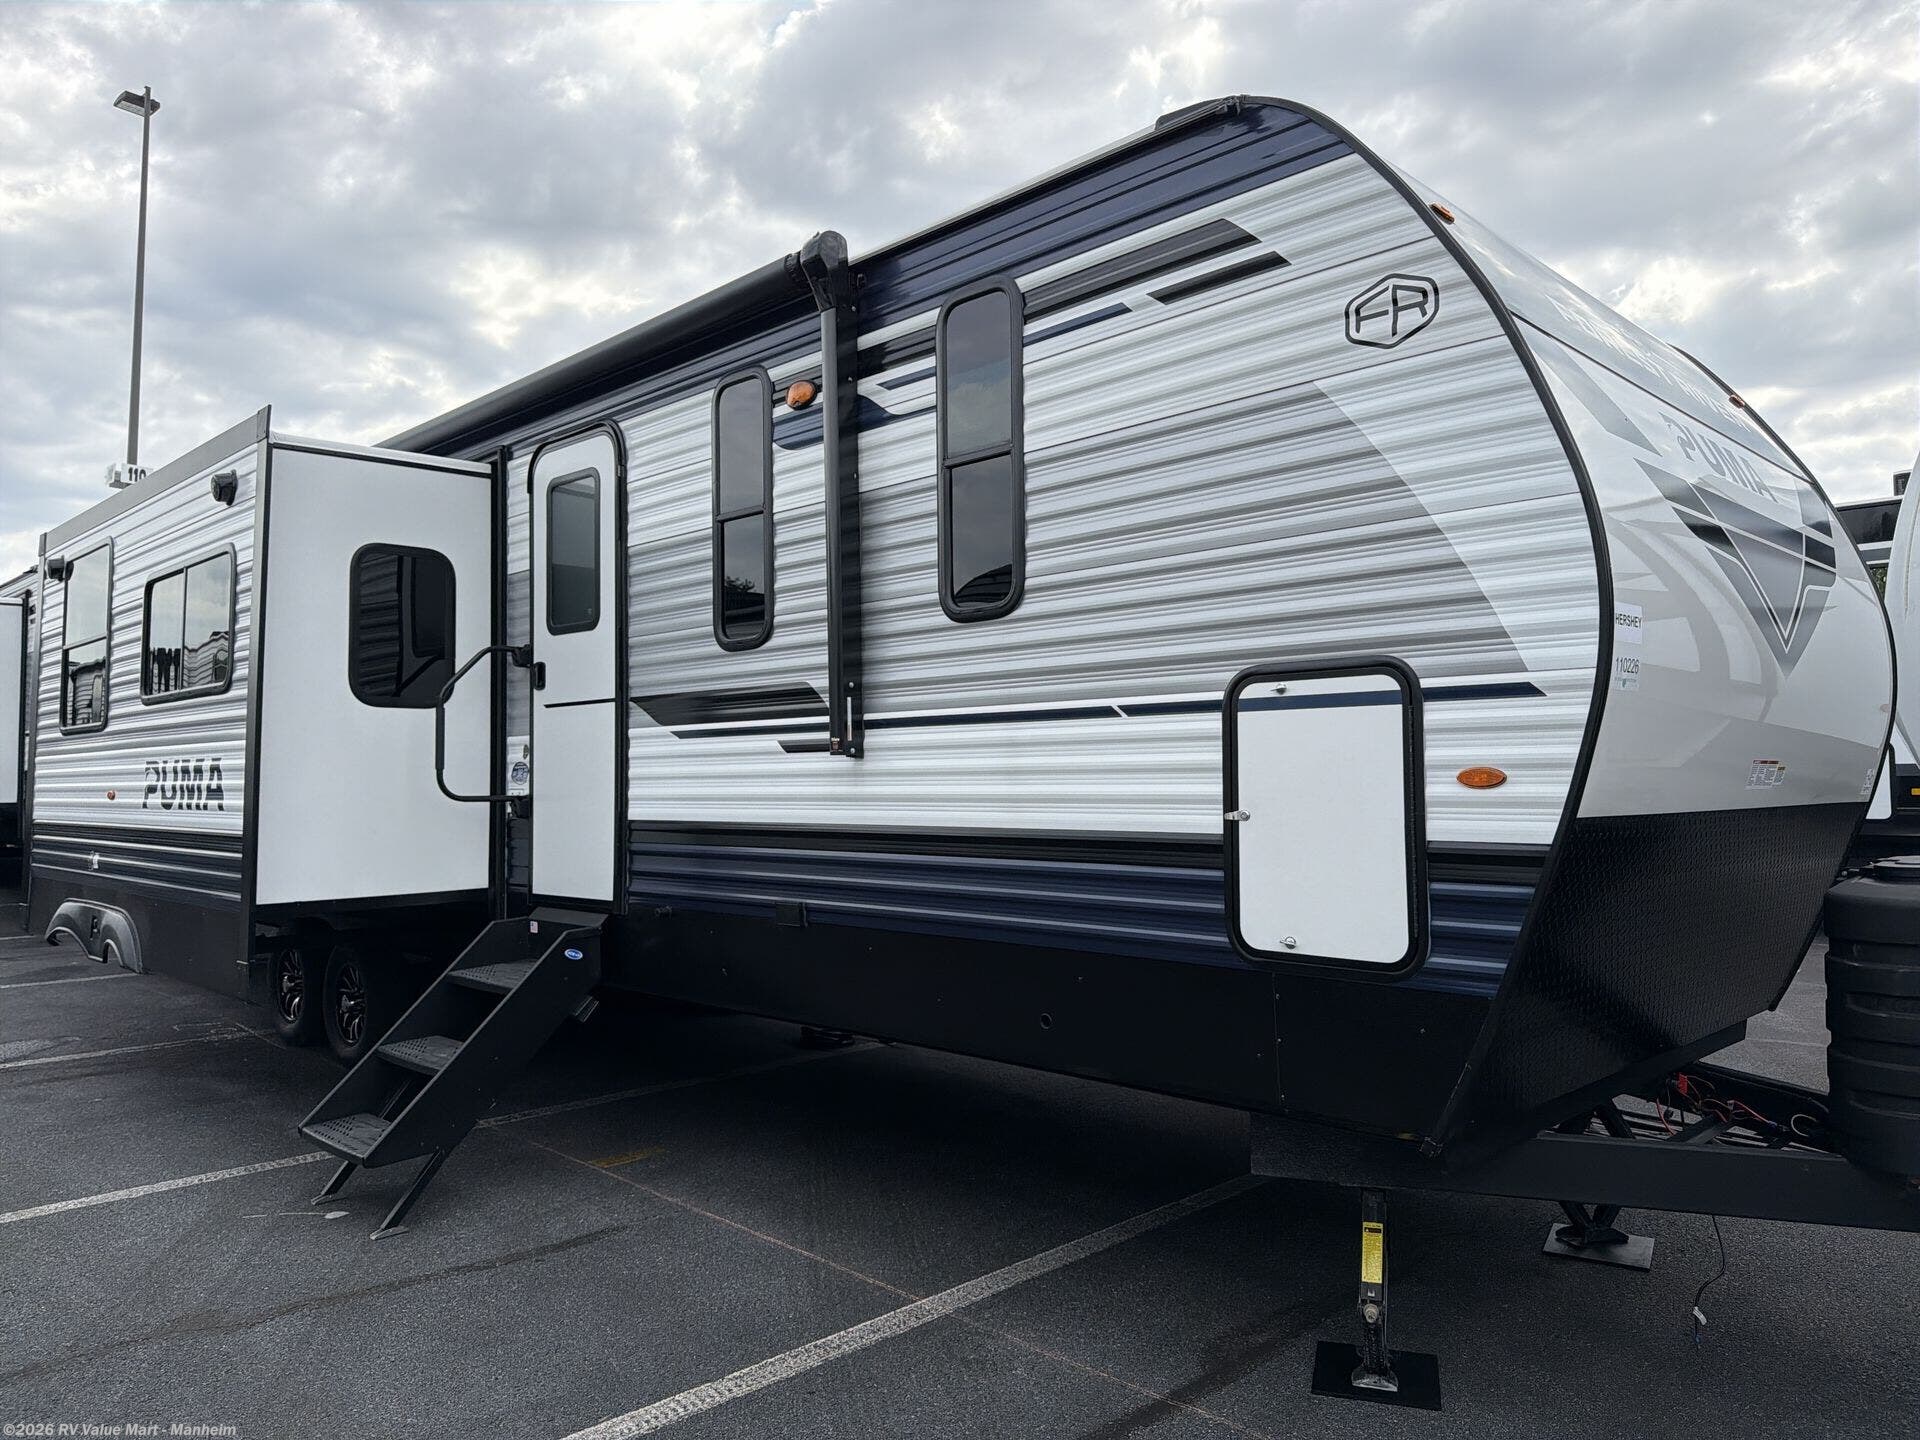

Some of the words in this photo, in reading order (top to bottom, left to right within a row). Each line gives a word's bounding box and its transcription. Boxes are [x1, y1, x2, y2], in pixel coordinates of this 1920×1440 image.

[1354, 283, 1429, 338] FR
[1658, 411, 1779, 503] PUMA
[1615, 612, 1643, 629] HERSHEY
[1615, 656, 1641, 675] 110226
[142, 757, 225, 811] PUMA
